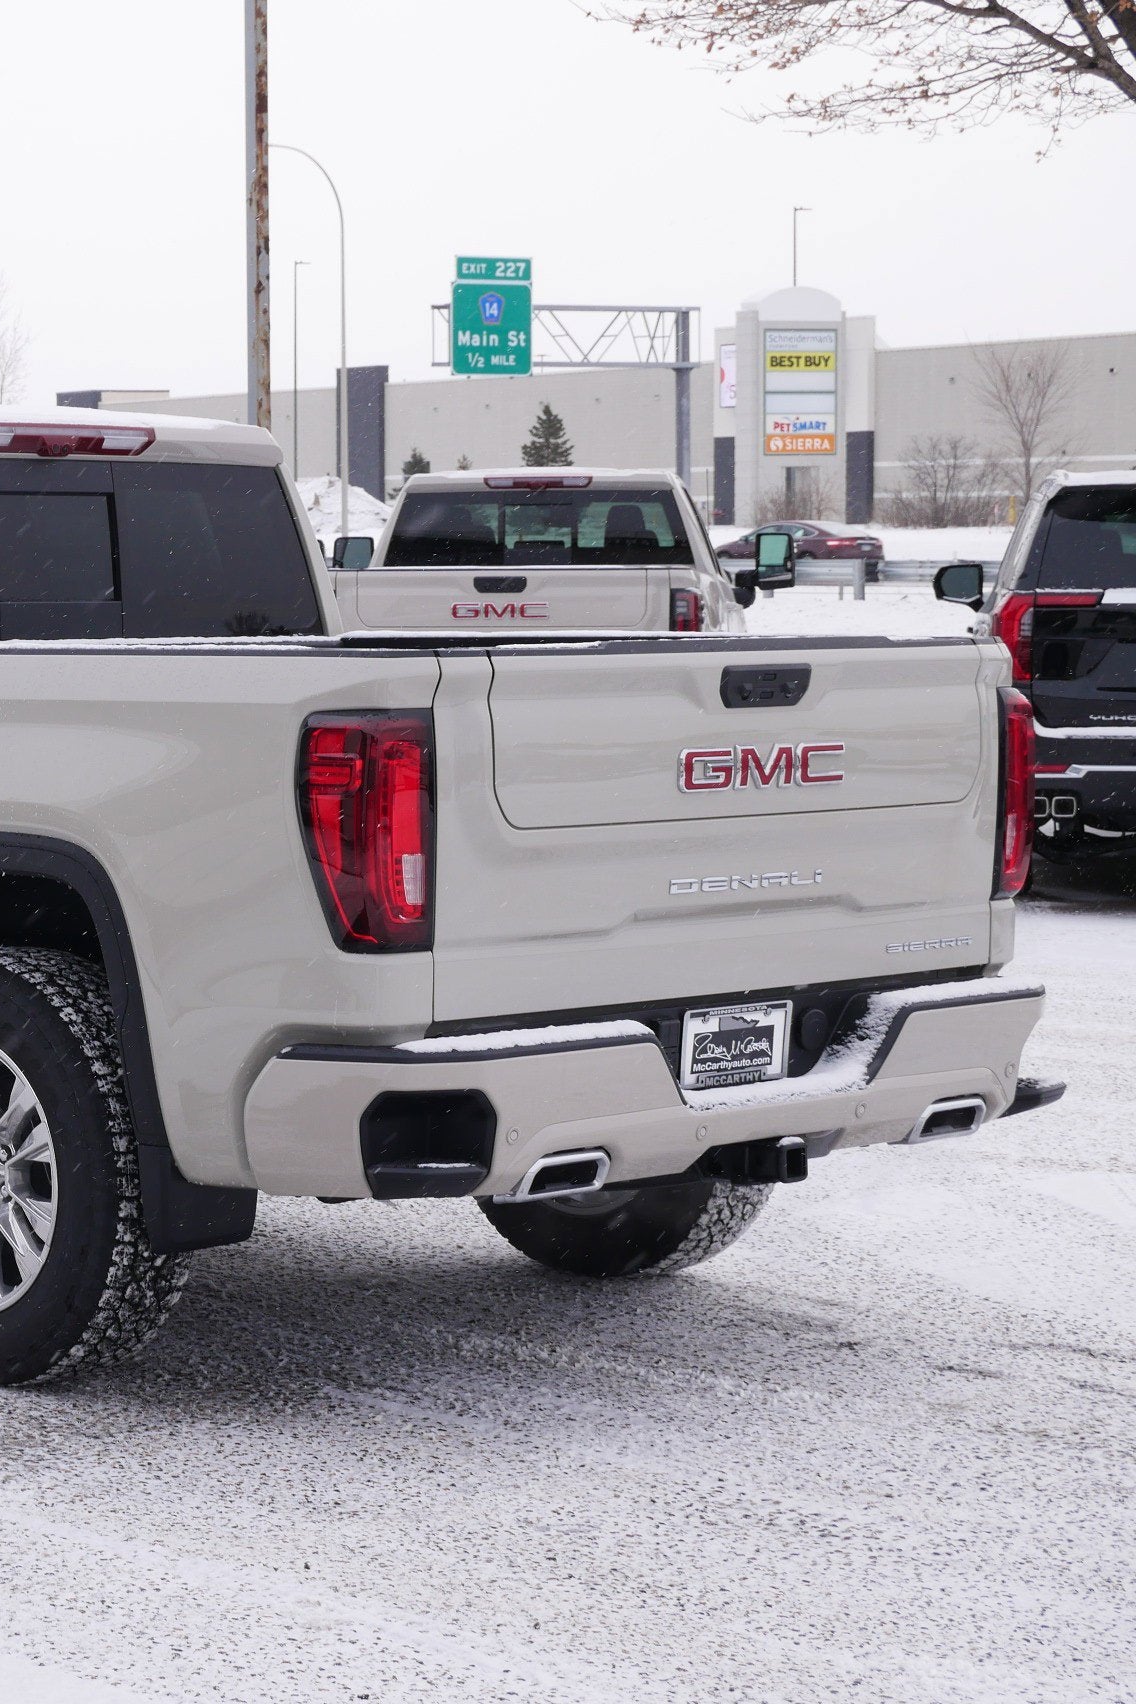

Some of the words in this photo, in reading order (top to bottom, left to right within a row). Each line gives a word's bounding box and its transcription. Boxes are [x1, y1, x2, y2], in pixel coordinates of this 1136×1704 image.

[462, 263, 487, 274] EXIT
[495, 262, 526, 277] 227
[485, 302, 498, 317] 14
[458, 330, 499, 346] Main
[507, 330, 526, 347] St
[491, 355, 516, 365] MILE
[770, 355, 802, 367] BEST
[804, 355, 831, 367] BUY
[784, 438, 831, 450] SIERRA
[451, 602, 549, 620] GMC
[678, 742, 845, 793] GMC
[669, 869, 823, 895] DENALI
[886, 936, 972, 953] SIERRA
[709, 1005, 768, 1016] MINNESOTA
[692, 1056, 771, 1073] McCarthyauto.com
[705, 1070, 760, 1087] MCCARTHY
